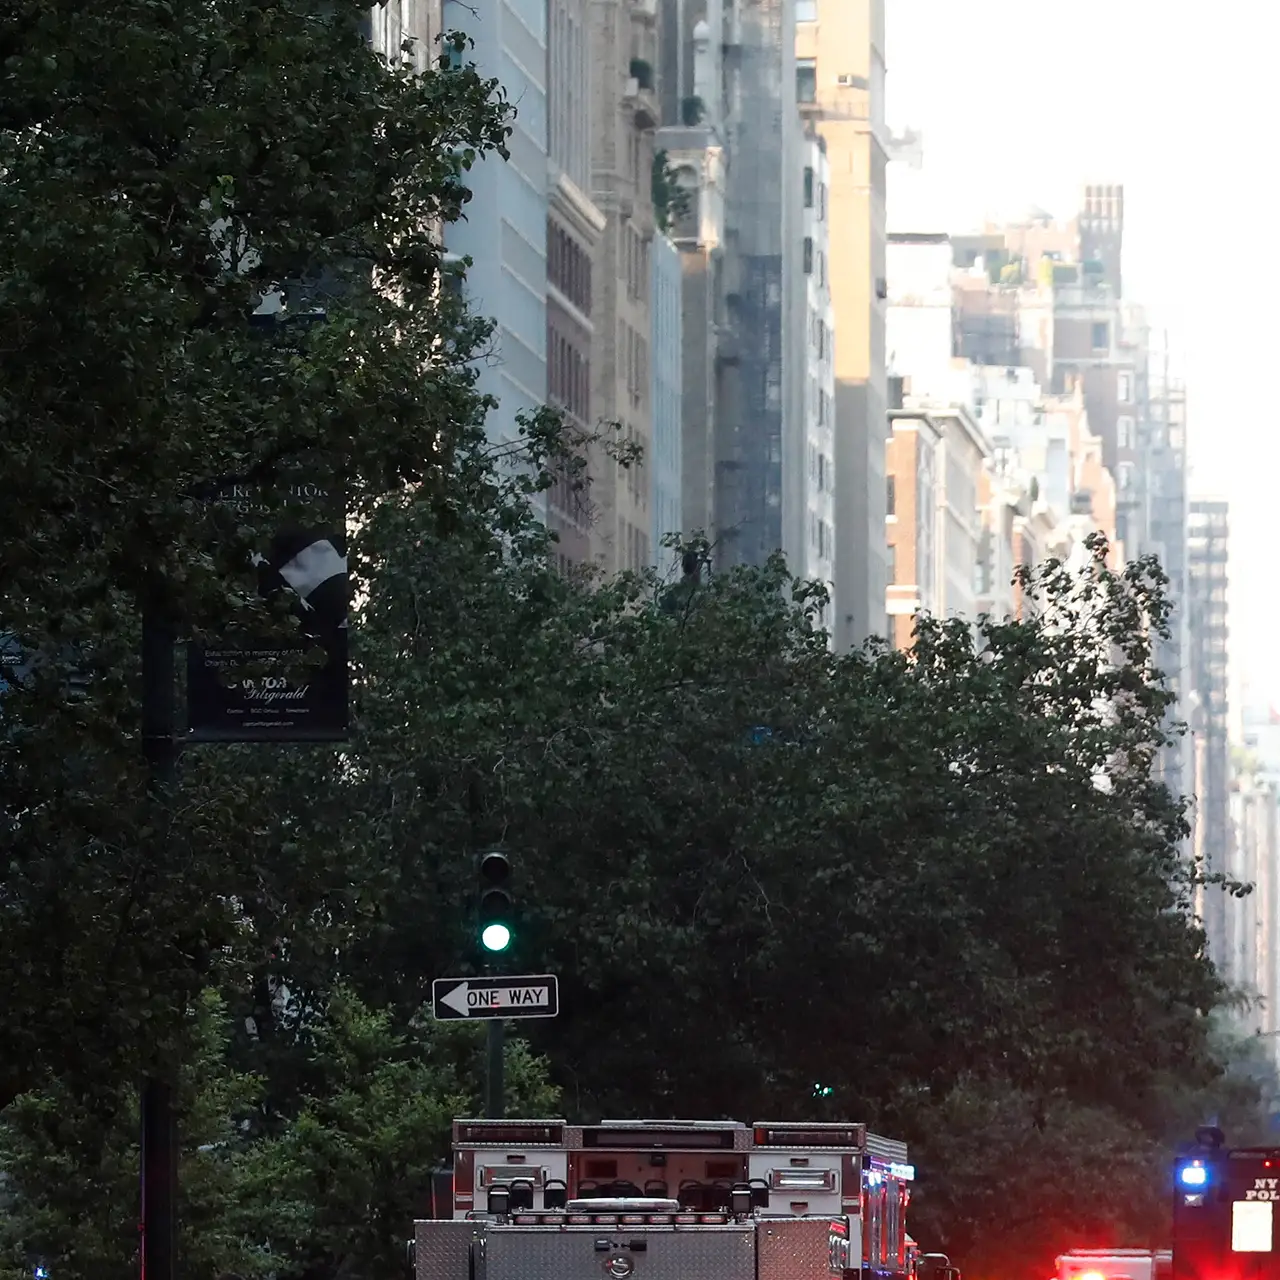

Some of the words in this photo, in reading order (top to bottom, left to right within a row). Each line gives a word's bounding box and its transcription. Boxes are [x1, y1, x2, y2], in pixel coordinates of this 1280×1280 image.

[467, 990, 500, 1006] ONE
[508, 988, 543, 1004] WAY
[1254, 1178, 1277, 1189] NY
[1245, 1190, 1280, 1200] POL
